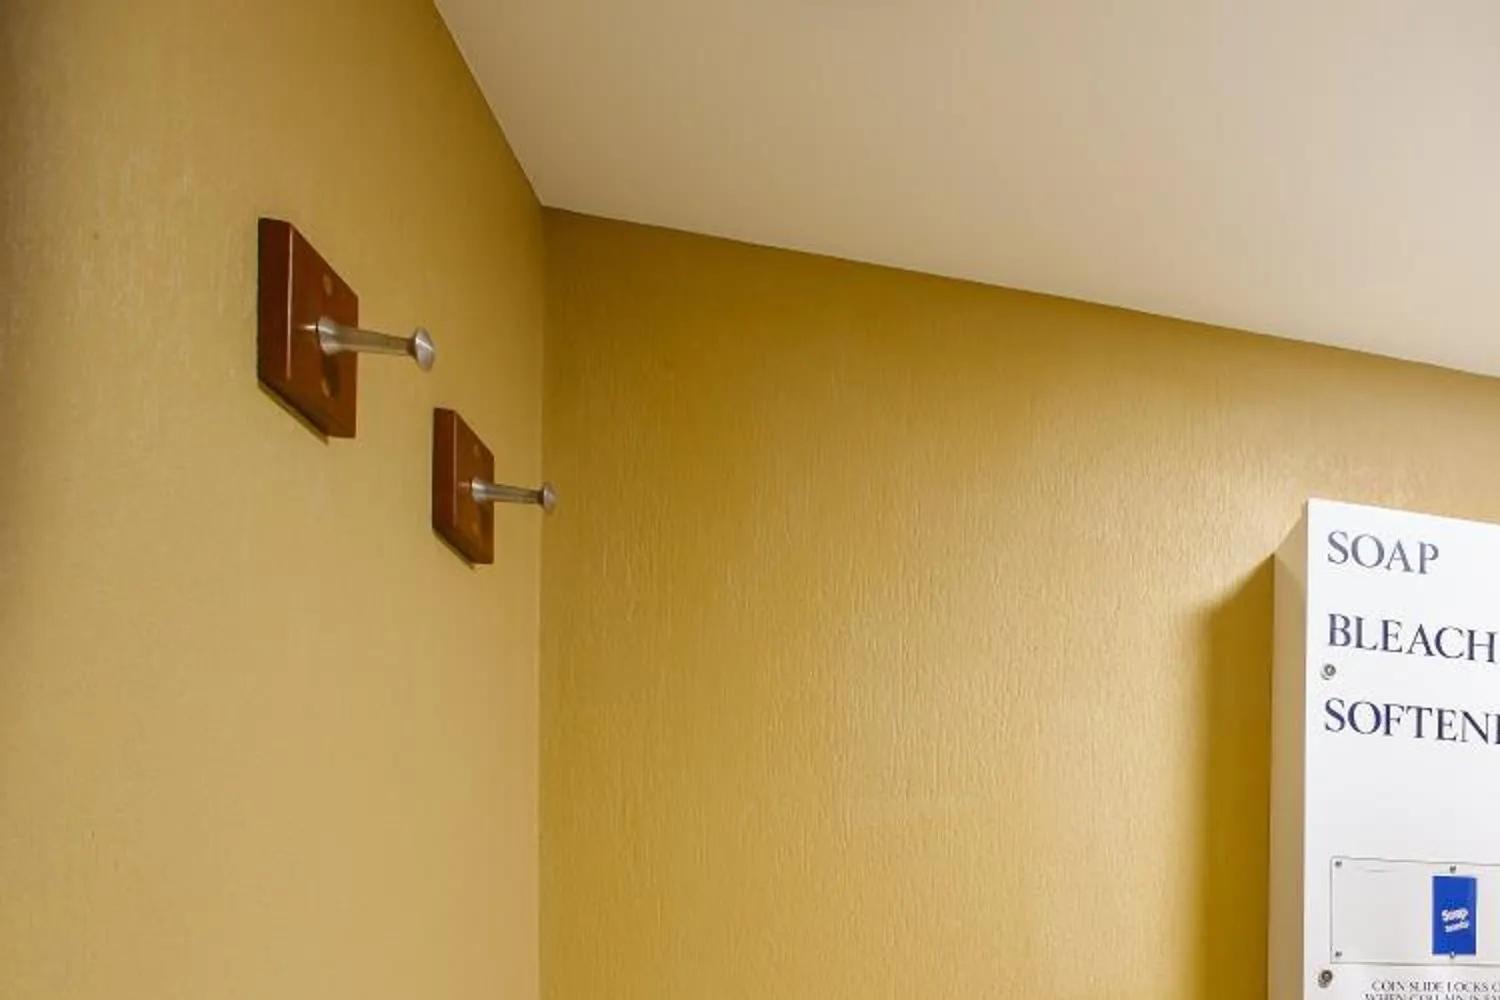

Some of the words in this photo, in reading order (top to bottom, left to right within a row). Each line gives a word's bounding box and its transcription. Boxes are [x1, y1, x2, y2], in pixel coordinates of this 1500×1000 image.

[1326, 529, 1440, 575] SOAP
[1327, 612, 1500, 663] BLEACH
[1371, 979, 1405, 993] COIN
[1409, 980, 1444, 993] SLIDE
[1447, 980, 1489, 993] LOCKS
